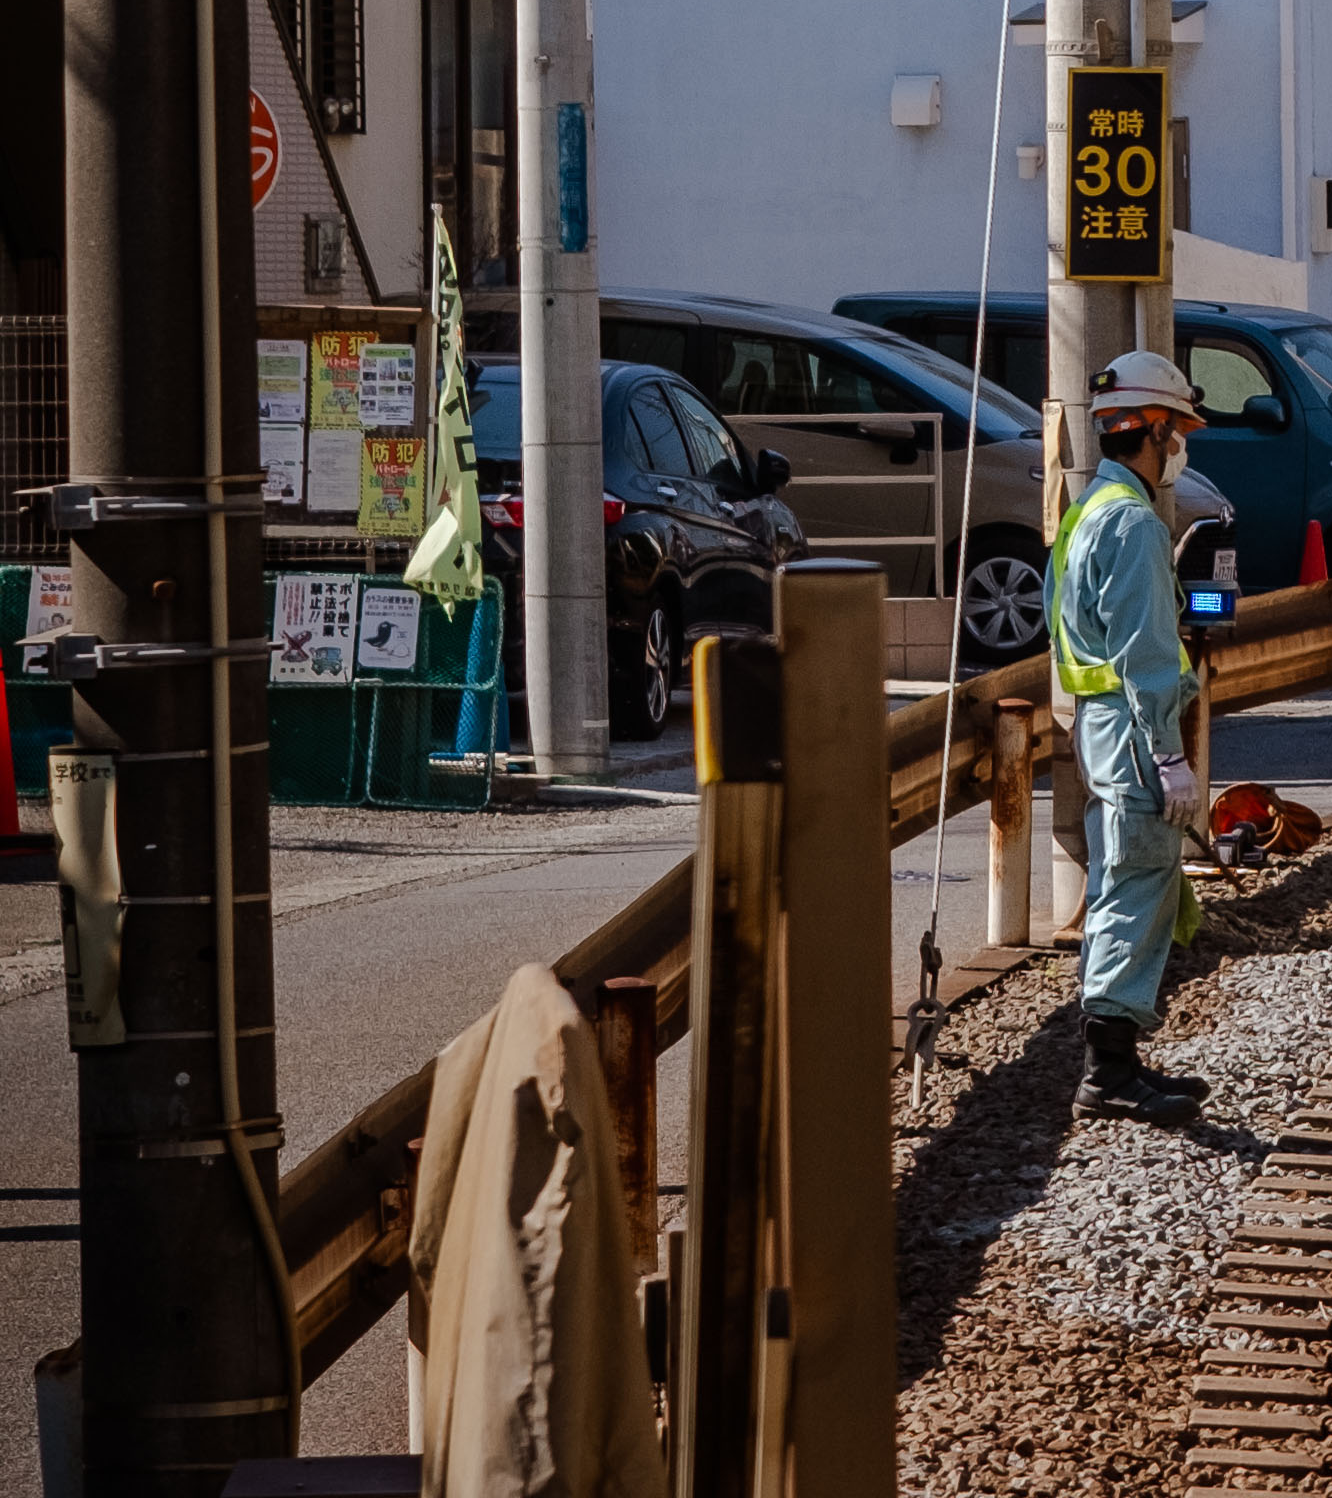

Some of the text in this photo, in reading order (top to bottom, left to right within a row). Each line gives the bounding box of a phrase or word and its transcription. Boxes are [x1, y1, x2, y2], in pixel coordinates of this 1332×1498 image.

[1088, 108, 1145, 138] 常時
[1075, 145, 1156, 197] 30
[1081, 205, 1149, 240] 注意
[321, 335, 367, 356] 防犯
[324, 357, 361, 367] パトロー
[372, 442, 415, 464] 防犯
[322, 582, 338, 637] 不法投棄
[338, 582, 352, 638] ポイ捨て
[55, 762, 111, 783] 学校まで
